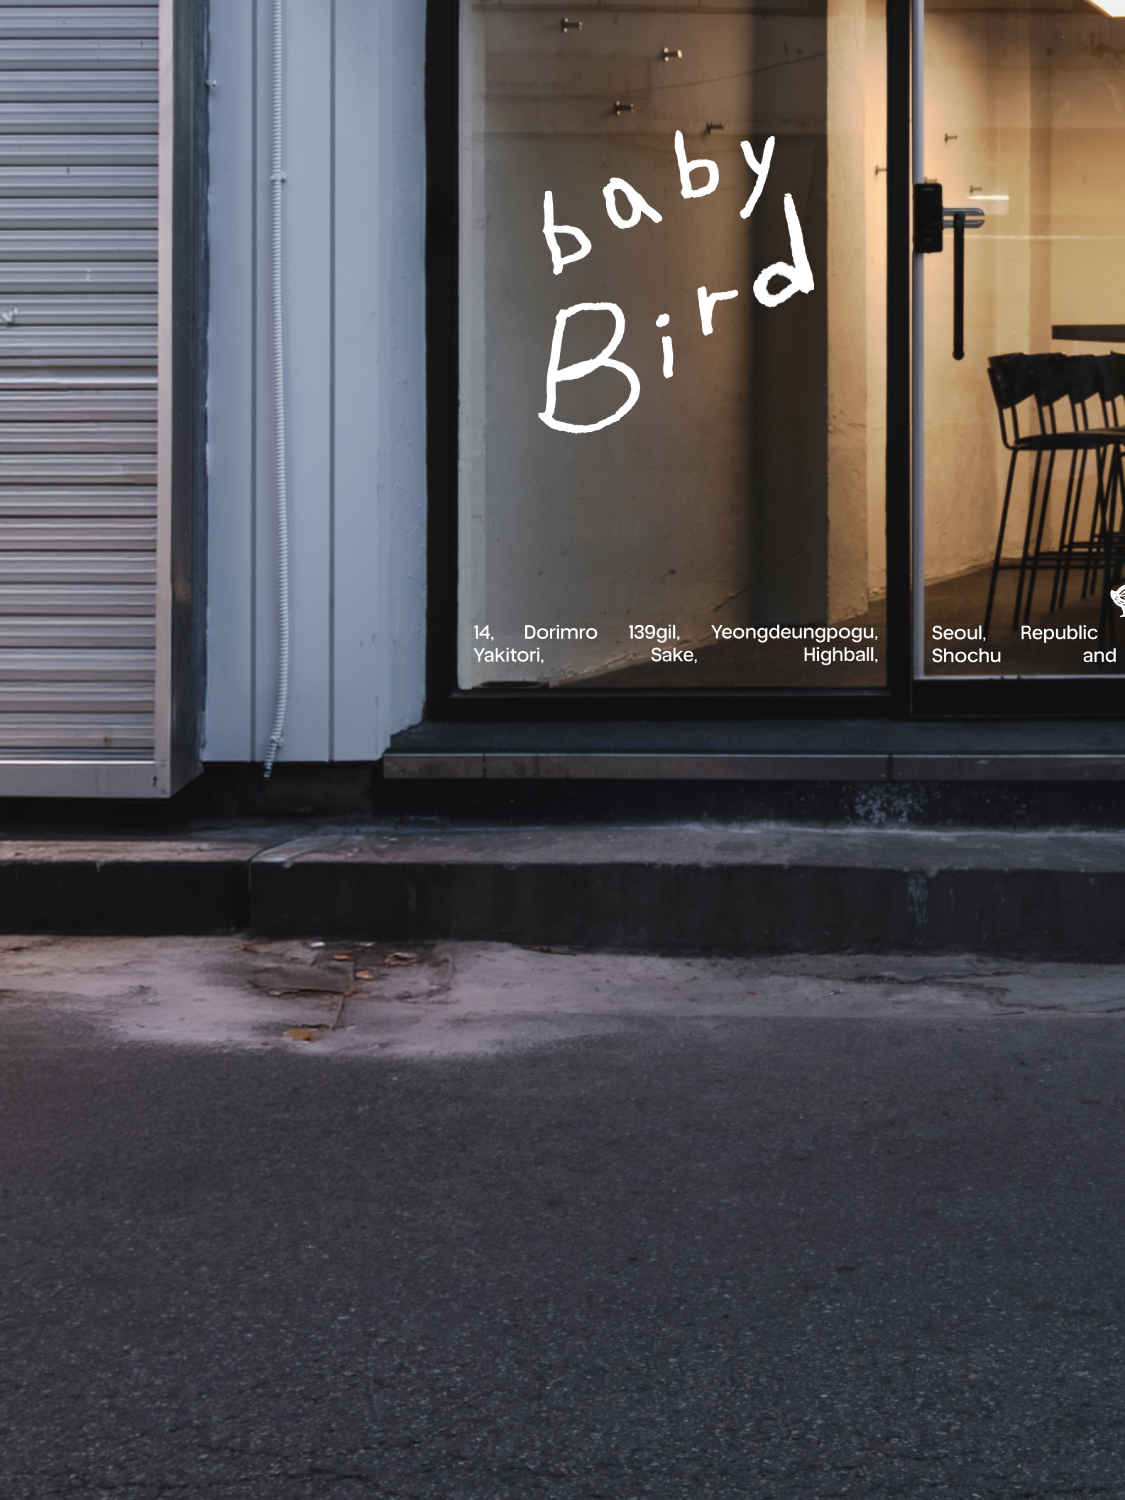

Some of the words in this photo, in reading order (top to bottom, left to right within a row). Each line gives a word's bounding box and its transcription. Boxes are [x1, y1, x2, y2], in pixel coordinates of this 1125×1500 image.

[542, 129, 776, 276] baby
[538, 192, 815, 434] Bird
[472, 624, 495, 642] 14,
[523, 624, 599, 640] Dorimro
[628, 624, 681, 644] 139gil,
[711, 624, 879, 644] Yeongdeungpogu,
[931, 624, 987, 643] Seoul,
[1020, 624, 1099, 644] Republic
[473, 646, 545, 664] Yakitori,
[650, 647, 698, 665] Sake,
[803, 646, 879, 666] Highball,
[931, 647, 1002, 664] Shochu
[1082, 647, 1117, 664] and
